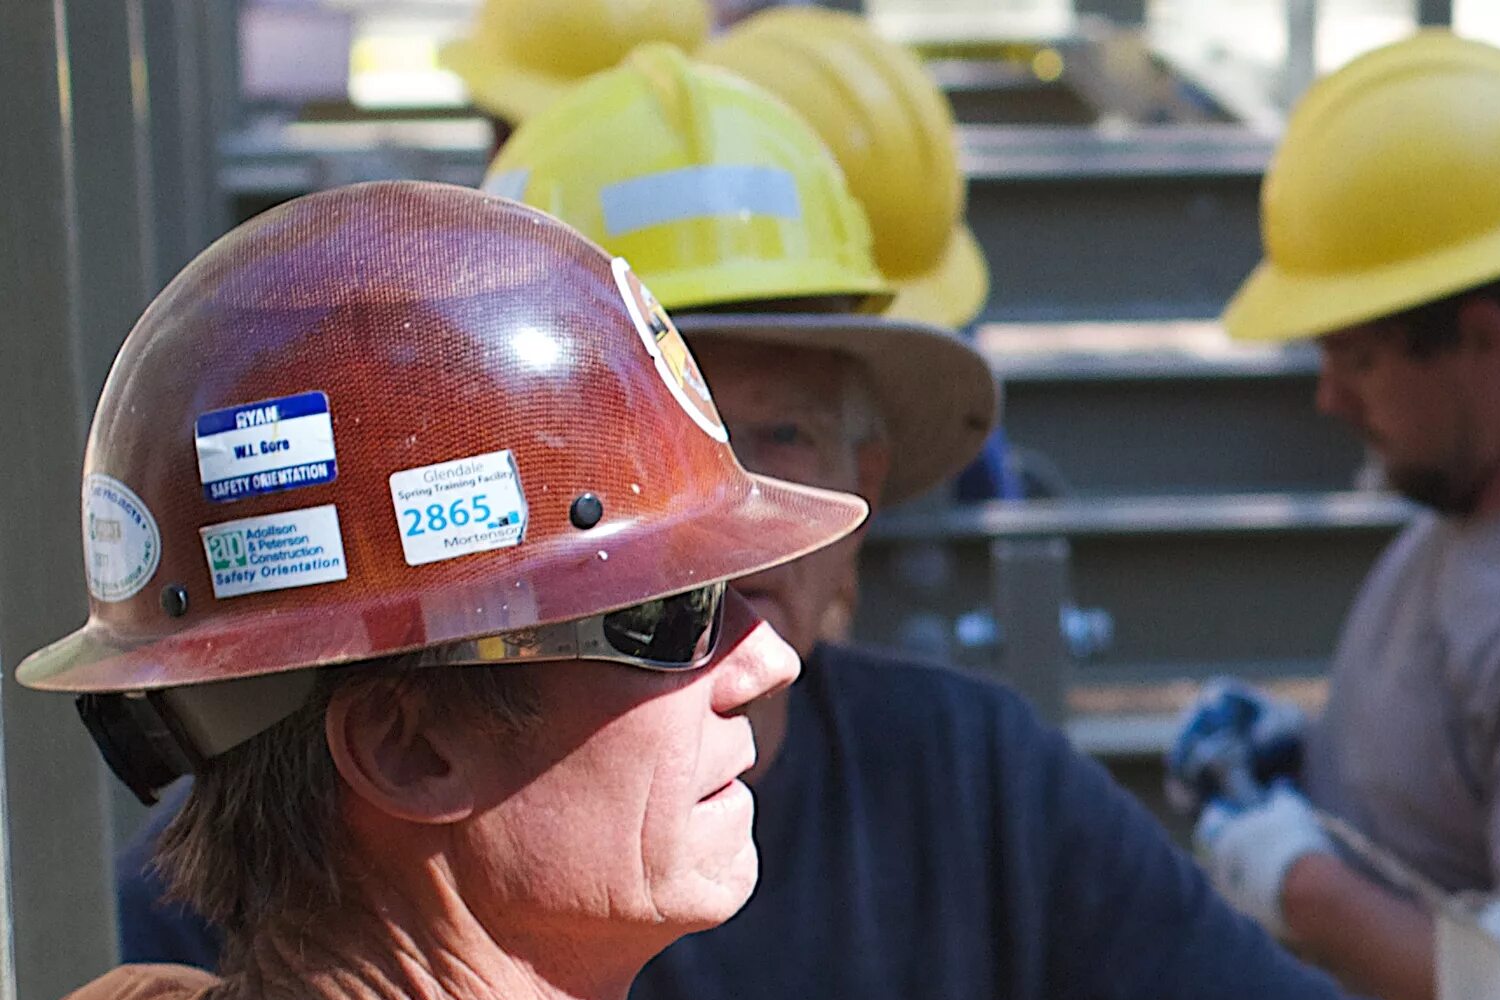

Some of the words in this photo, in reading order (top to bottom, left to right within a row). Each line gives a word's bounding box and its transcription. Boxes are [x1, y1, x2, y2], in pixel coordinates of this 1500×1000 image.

[236, 405, 279, 429] RYAN
[260, 438, 290, 454] Gore
[211, 476, 250, 499] SAFETY
[253, 462, 328, 489] ORIENTATION
[423, 461, 484, 484] Glendale
[398, 486, 432, 501] Spring
[435, 477, 476, 493] Training
[478, 469, 513, 483] Facility
[403, 494, 491, 537] 2865
[249, 545, 324, 565] Construction
[259, 535, 309, 551] Peterson
[215, 570, 256, 586] Safety
[261, 556, 340, 578] Orientation
